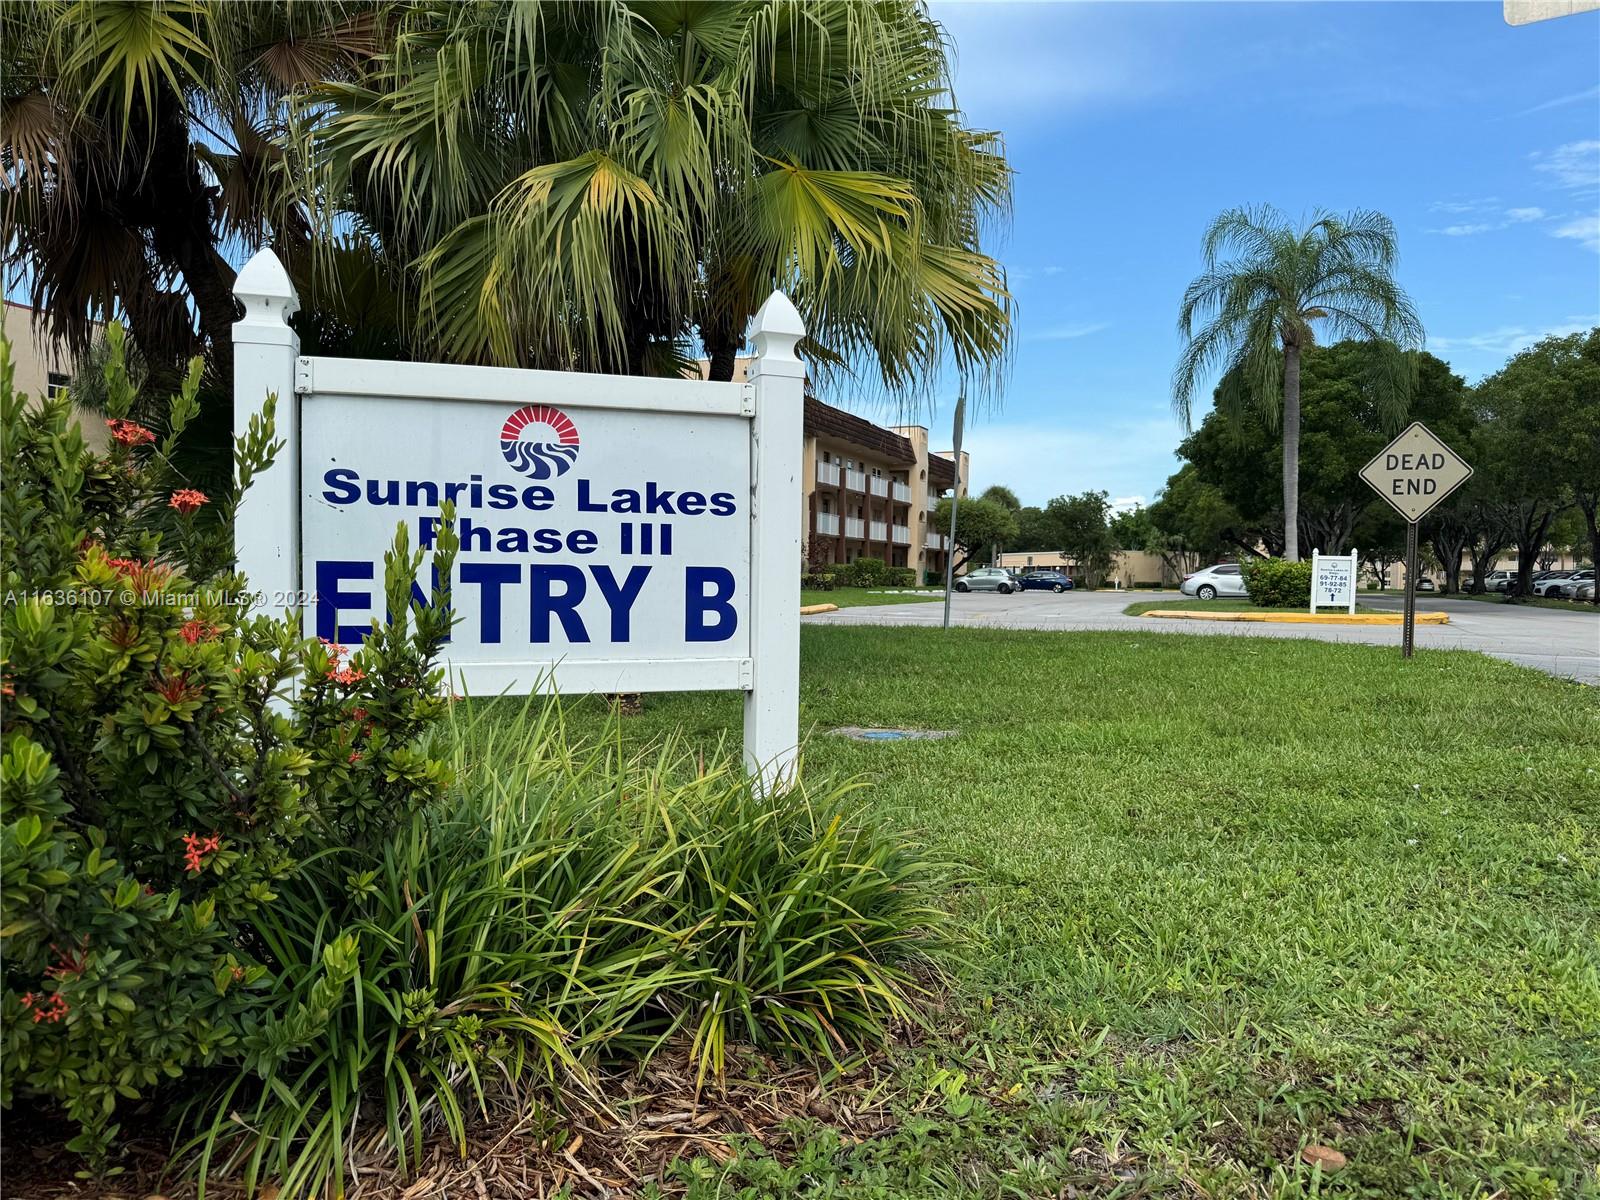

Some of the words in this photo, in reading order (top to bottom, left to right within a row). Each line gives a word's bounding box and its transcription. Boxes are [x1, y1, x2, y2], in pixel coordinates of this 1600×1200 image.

[1386, 453, 1445, 470] DEAD
[322, 468, 555, 511] Sunrise
[577, 479, 737, 516] Lakes
[1392, 478, 1437, 495] END
[620, 522, 673, 555] III
[315, 560, 653, 645] ETRY
[685, 566, 738, 642] B
